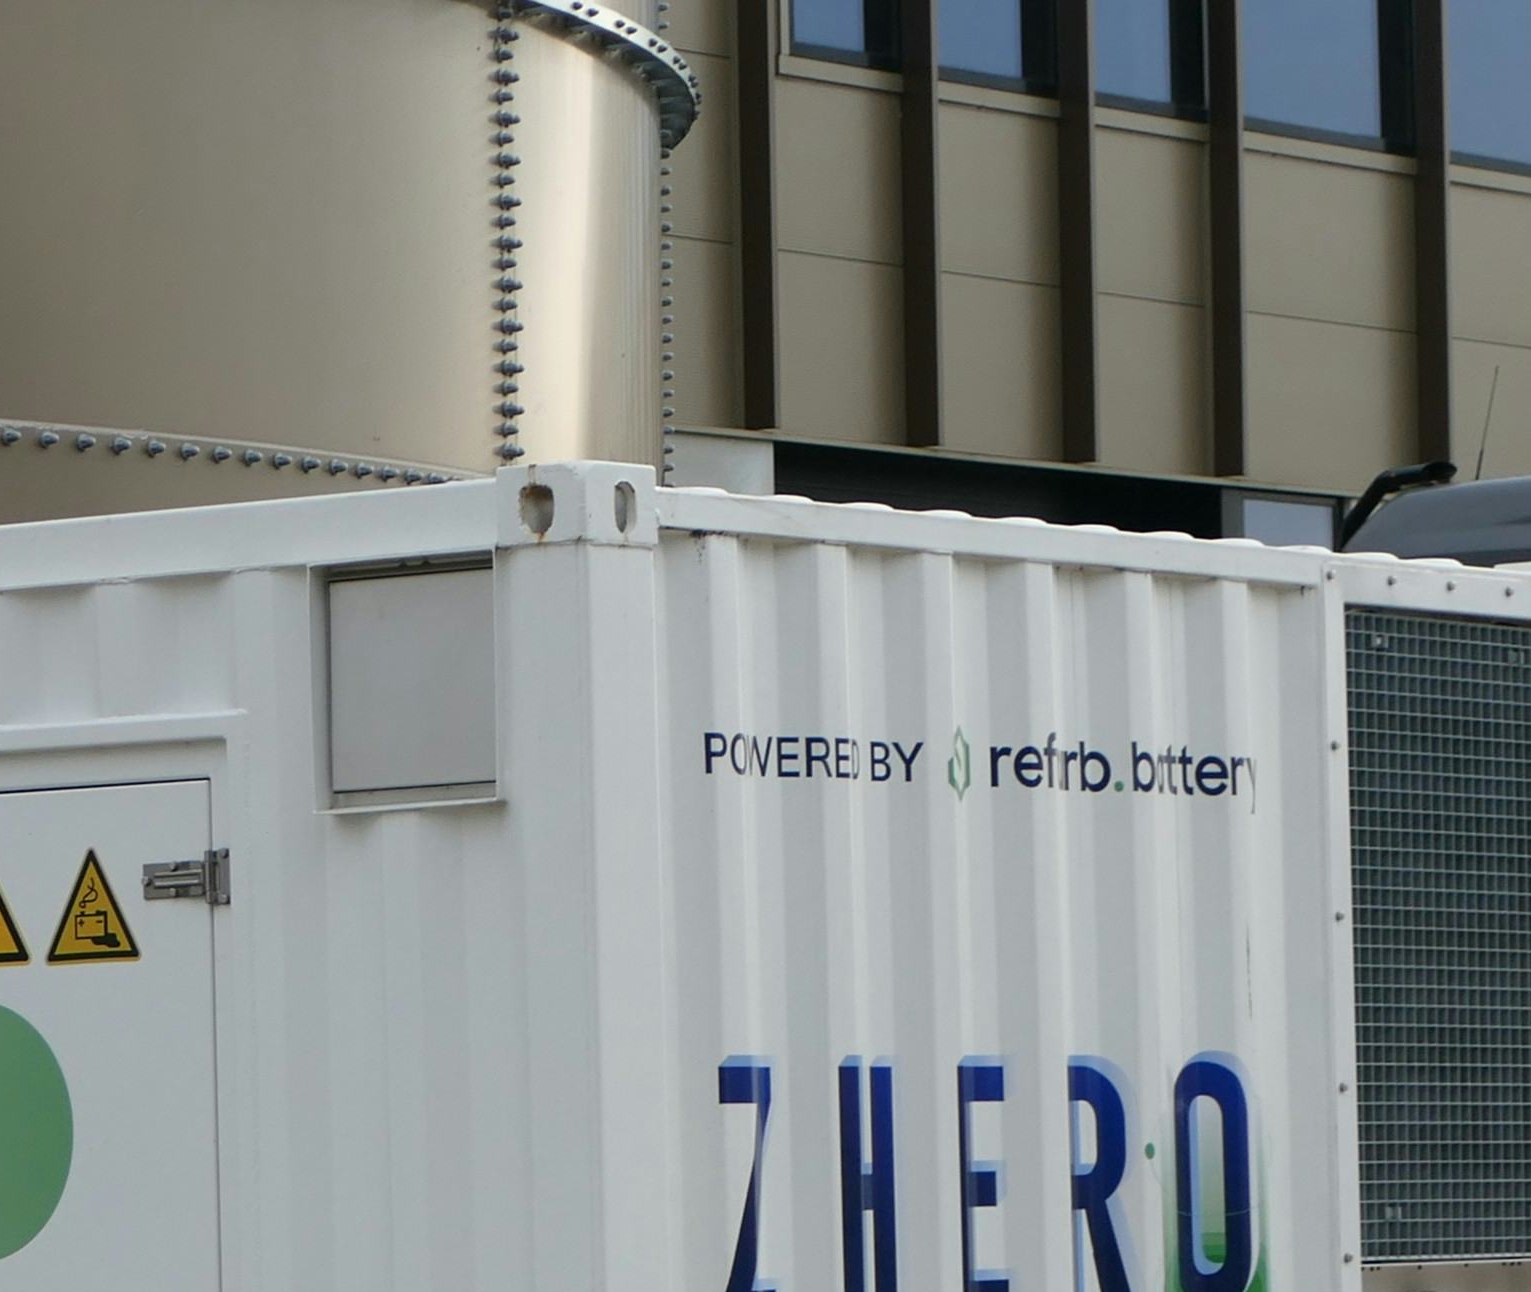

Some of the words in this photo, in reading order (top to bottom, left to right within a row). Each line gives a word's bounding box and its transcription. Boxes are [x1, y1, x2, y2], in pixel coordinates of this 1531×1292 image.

[704, 732, 860, 780] POWERED
[870, 741, 924, 782] BY
[989, 732, 1256, 814] refrb.battery
